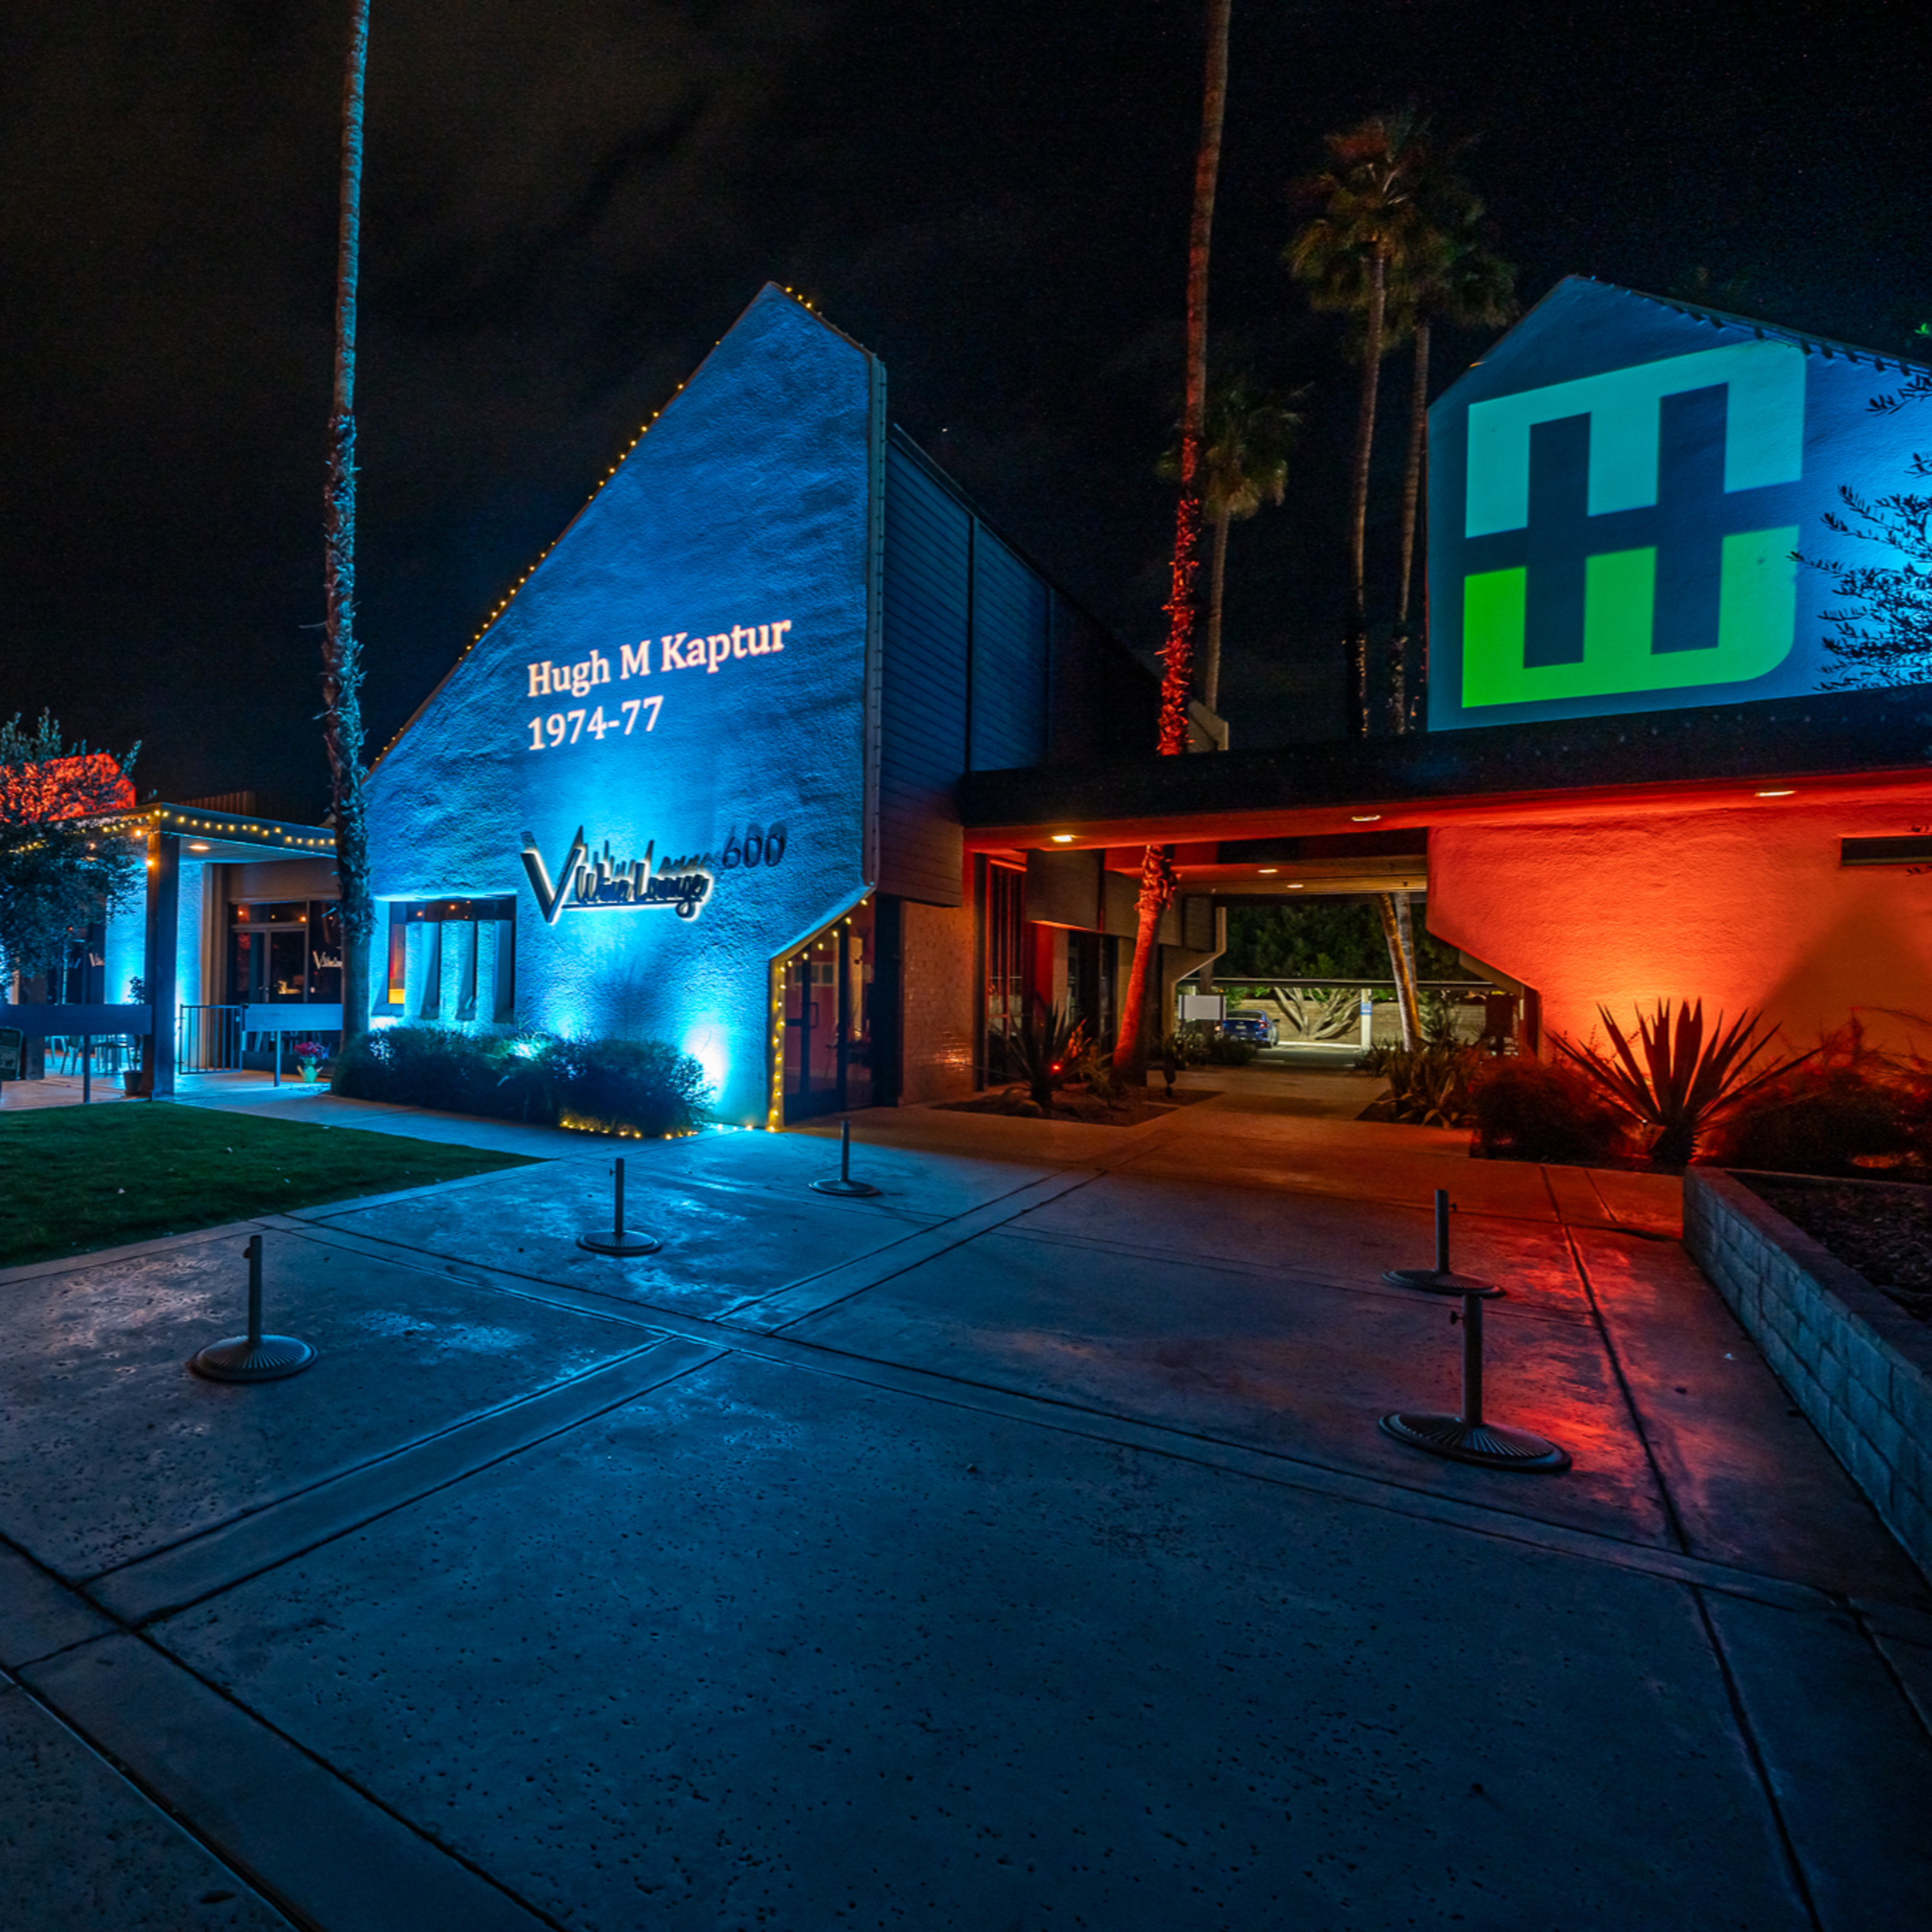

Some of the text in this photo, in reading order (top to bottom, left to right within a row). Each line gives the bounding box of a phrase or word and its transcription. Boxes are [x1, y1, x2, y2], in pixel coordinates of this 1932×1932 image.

[527, 620, 792, 697] Hugh M Kaptur
[527, 696, 664, 751] 1974-77
[722, 833, 785, 869] 600
